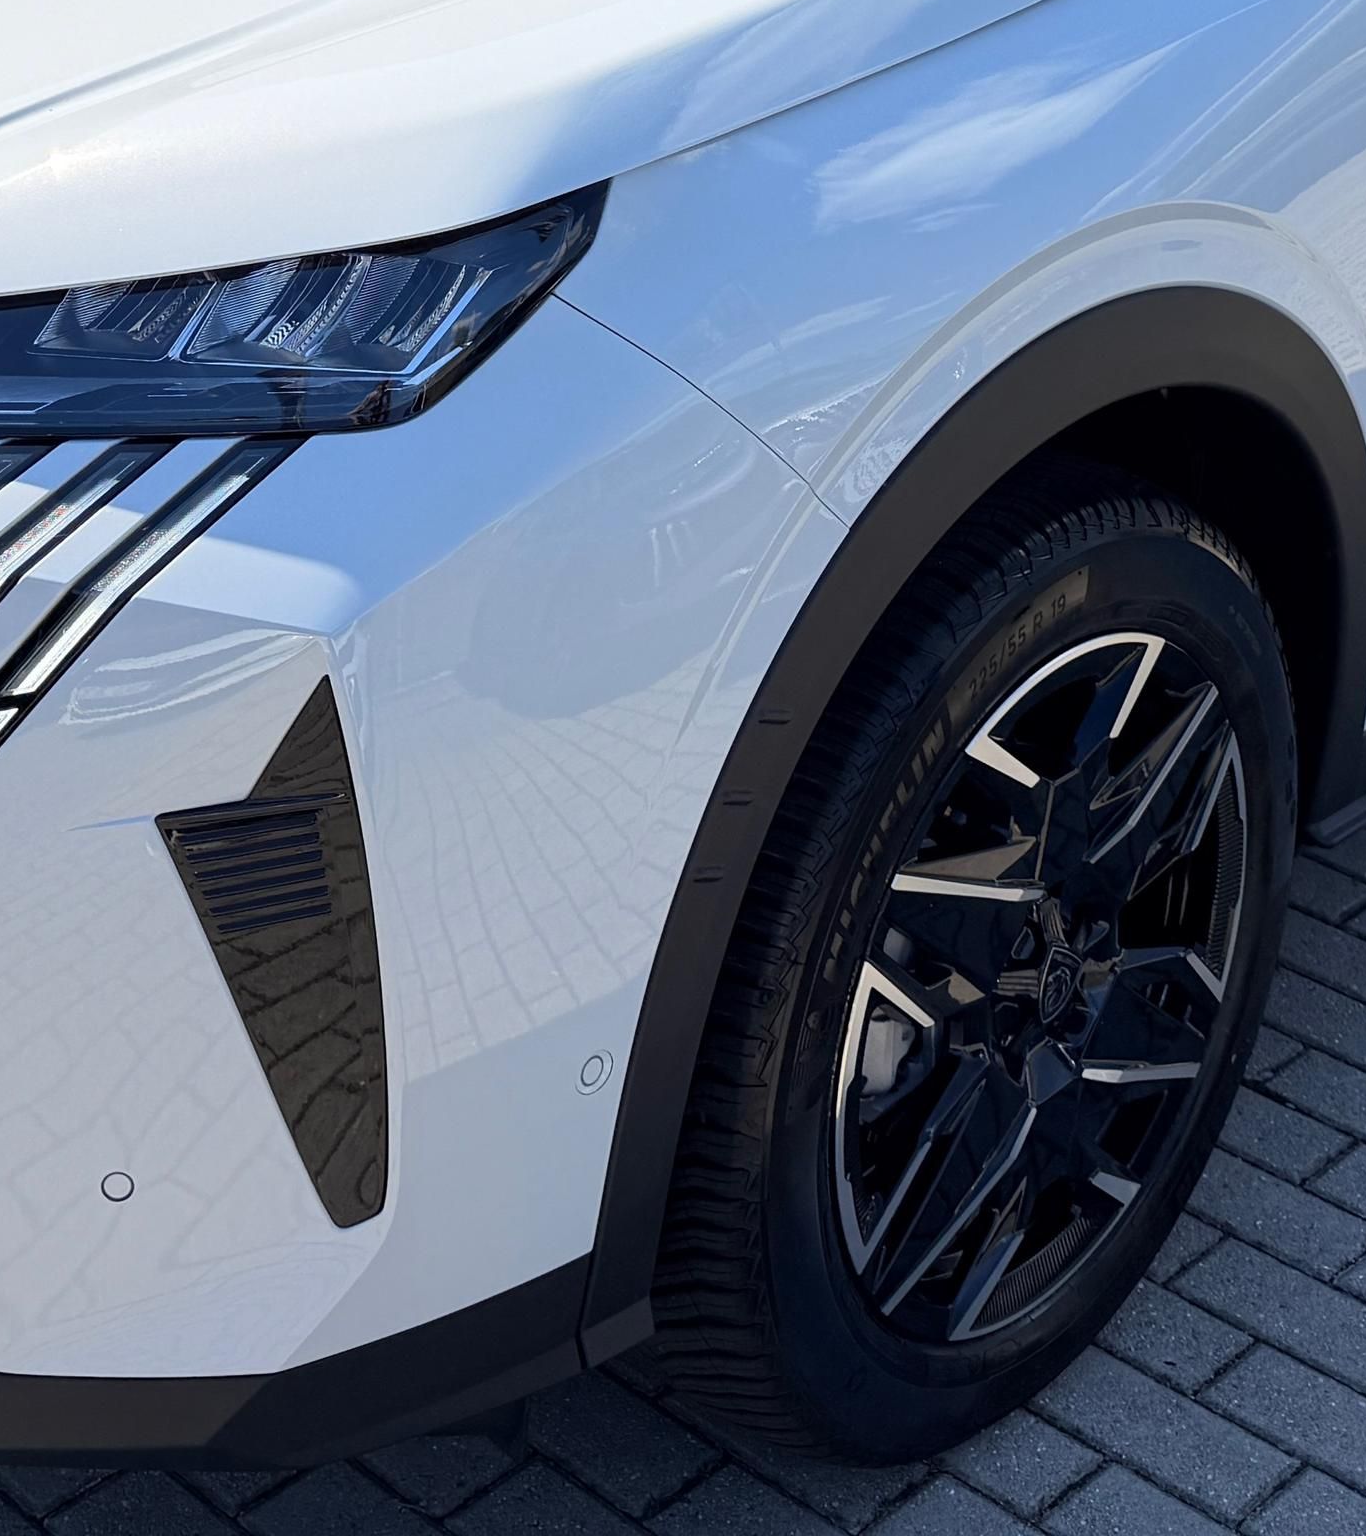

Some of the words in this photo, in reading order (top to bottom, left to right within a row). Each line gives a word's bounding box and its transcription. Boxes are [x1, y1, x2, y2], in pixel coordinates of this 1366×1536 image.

[969, 624, 1027, 702] 225/55
[1032, 611, 1044, 635] R
[1050, 594, 1066, 618] 19
